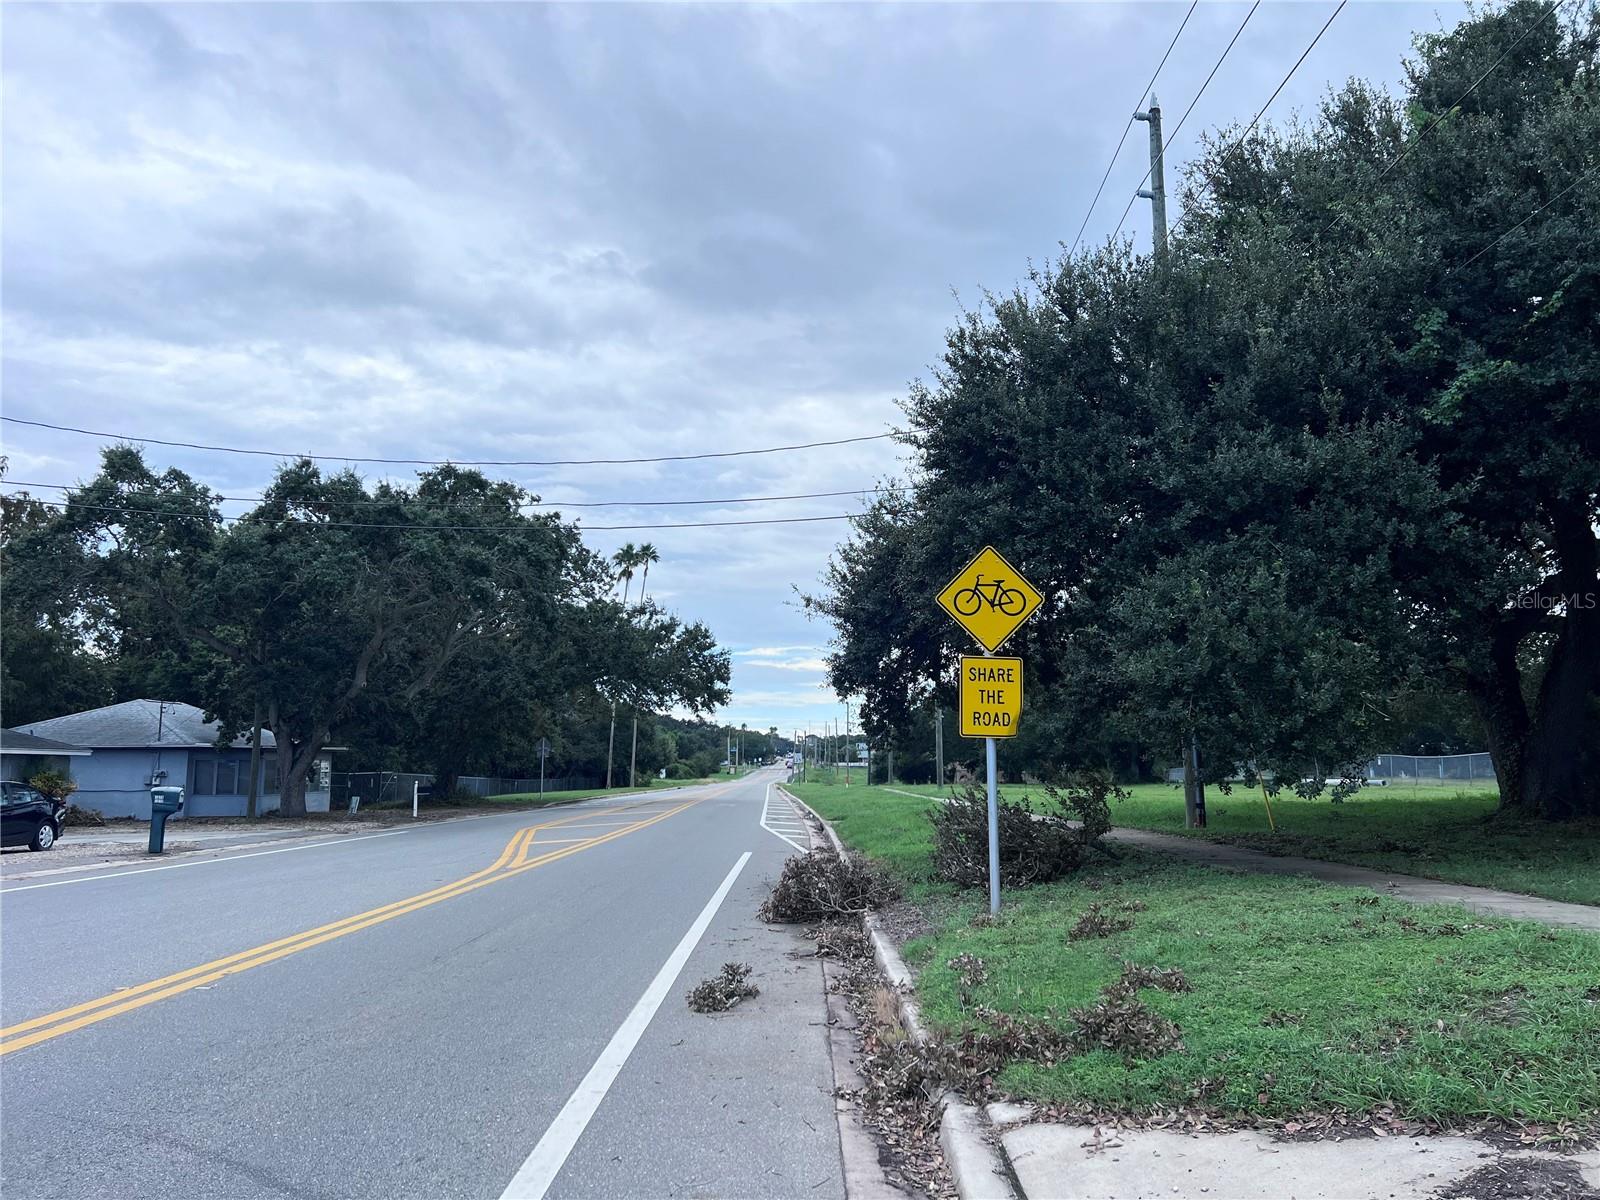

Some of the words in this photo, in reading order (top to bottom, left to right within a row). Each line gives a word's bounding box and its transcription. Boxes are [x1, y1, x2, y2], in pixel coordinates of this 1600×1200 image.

[968, 667, 1015, 683] SHARE
[978, 689, 1005, 704] THE
[973, 711, 1011, 727] ROAD
